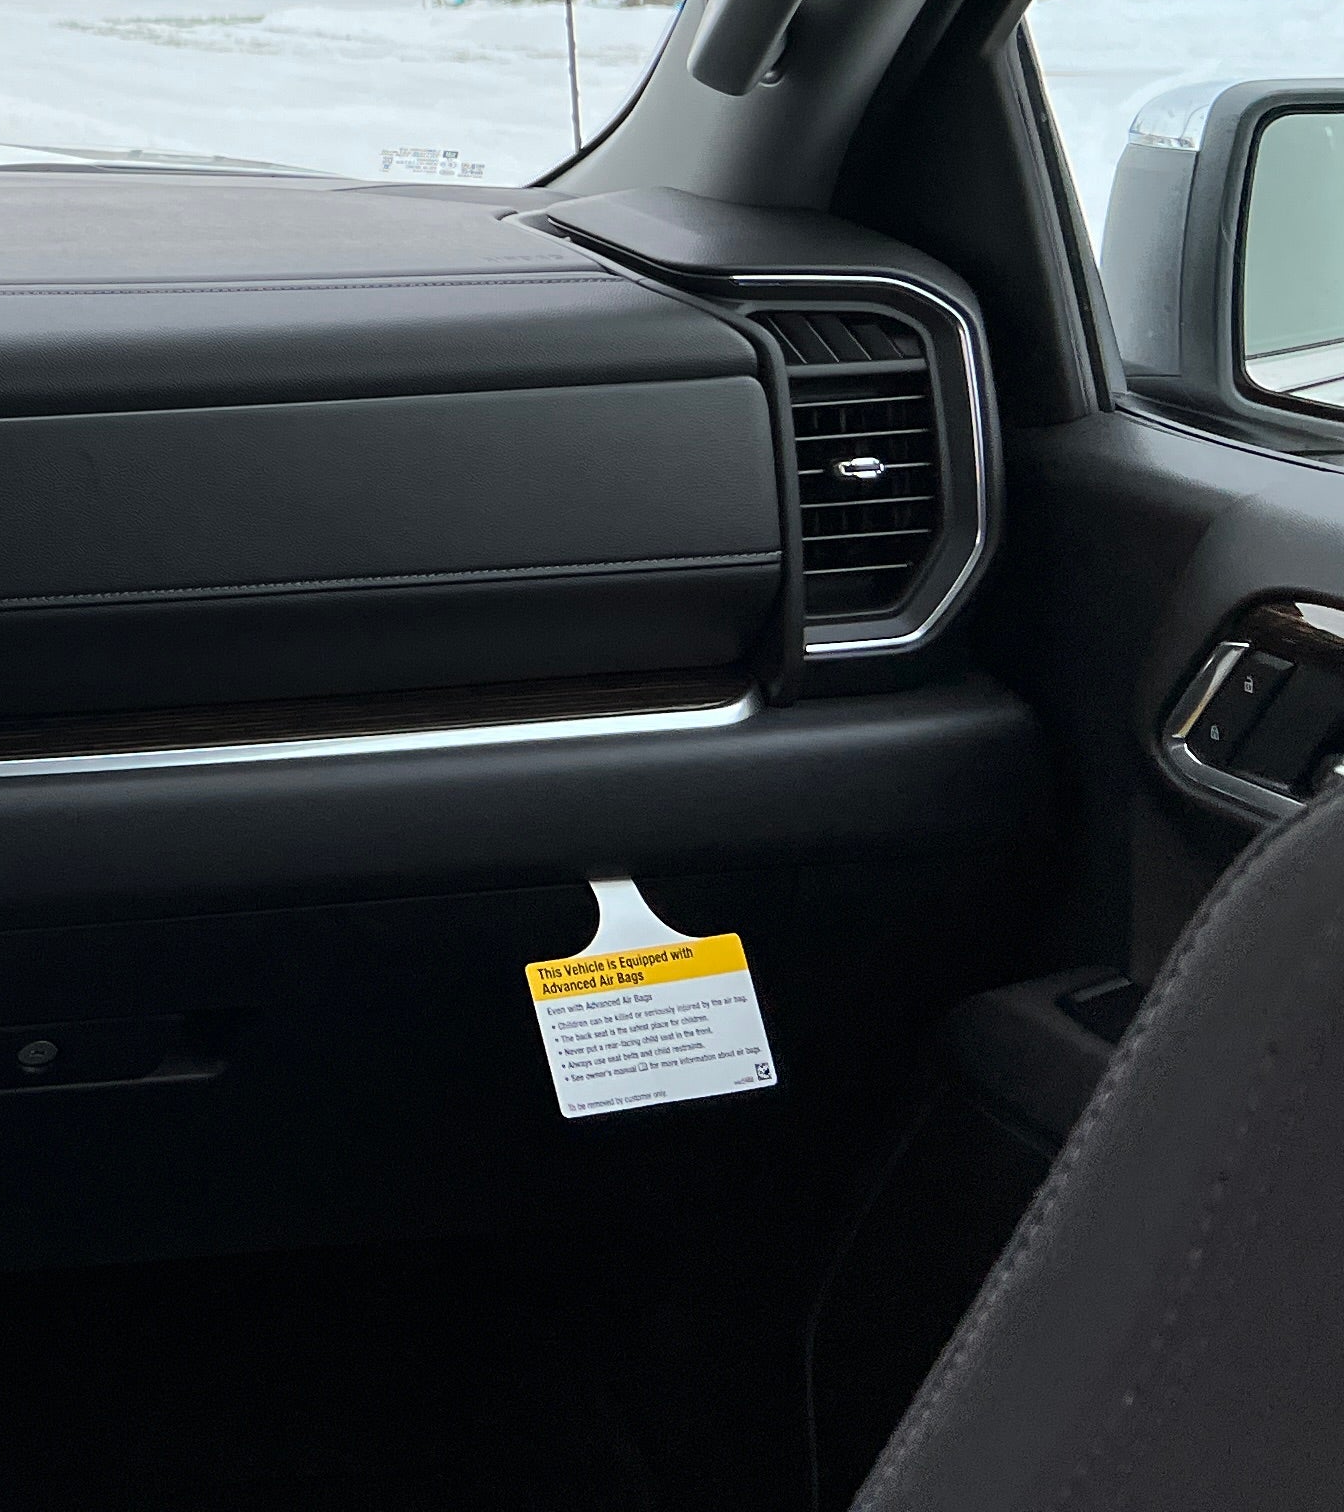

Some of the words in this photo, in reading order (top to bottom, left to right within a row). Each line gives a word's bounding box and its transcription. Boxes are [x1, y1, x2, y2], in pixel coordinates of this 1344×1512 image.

[538, 967, 562, 981] This
[564, 960, 604, 977] Vehicle
[606, 958, 616, 970] is
[619, 950, 668, 970] Equipped
[670, 946, 692, 960] with
[542, 977, 596, 995] Advanced
[599, 974, 614, 986] Air
[617, 969, 644, 986] Bags
[546, 1005, 566, 1015] Even
[566, 1002, 584, 1012] with
[584, 997, 621, 1009] Advanced
[621, 995, 632, 1003] Air
[633, 992, 653, 1004] Bags
